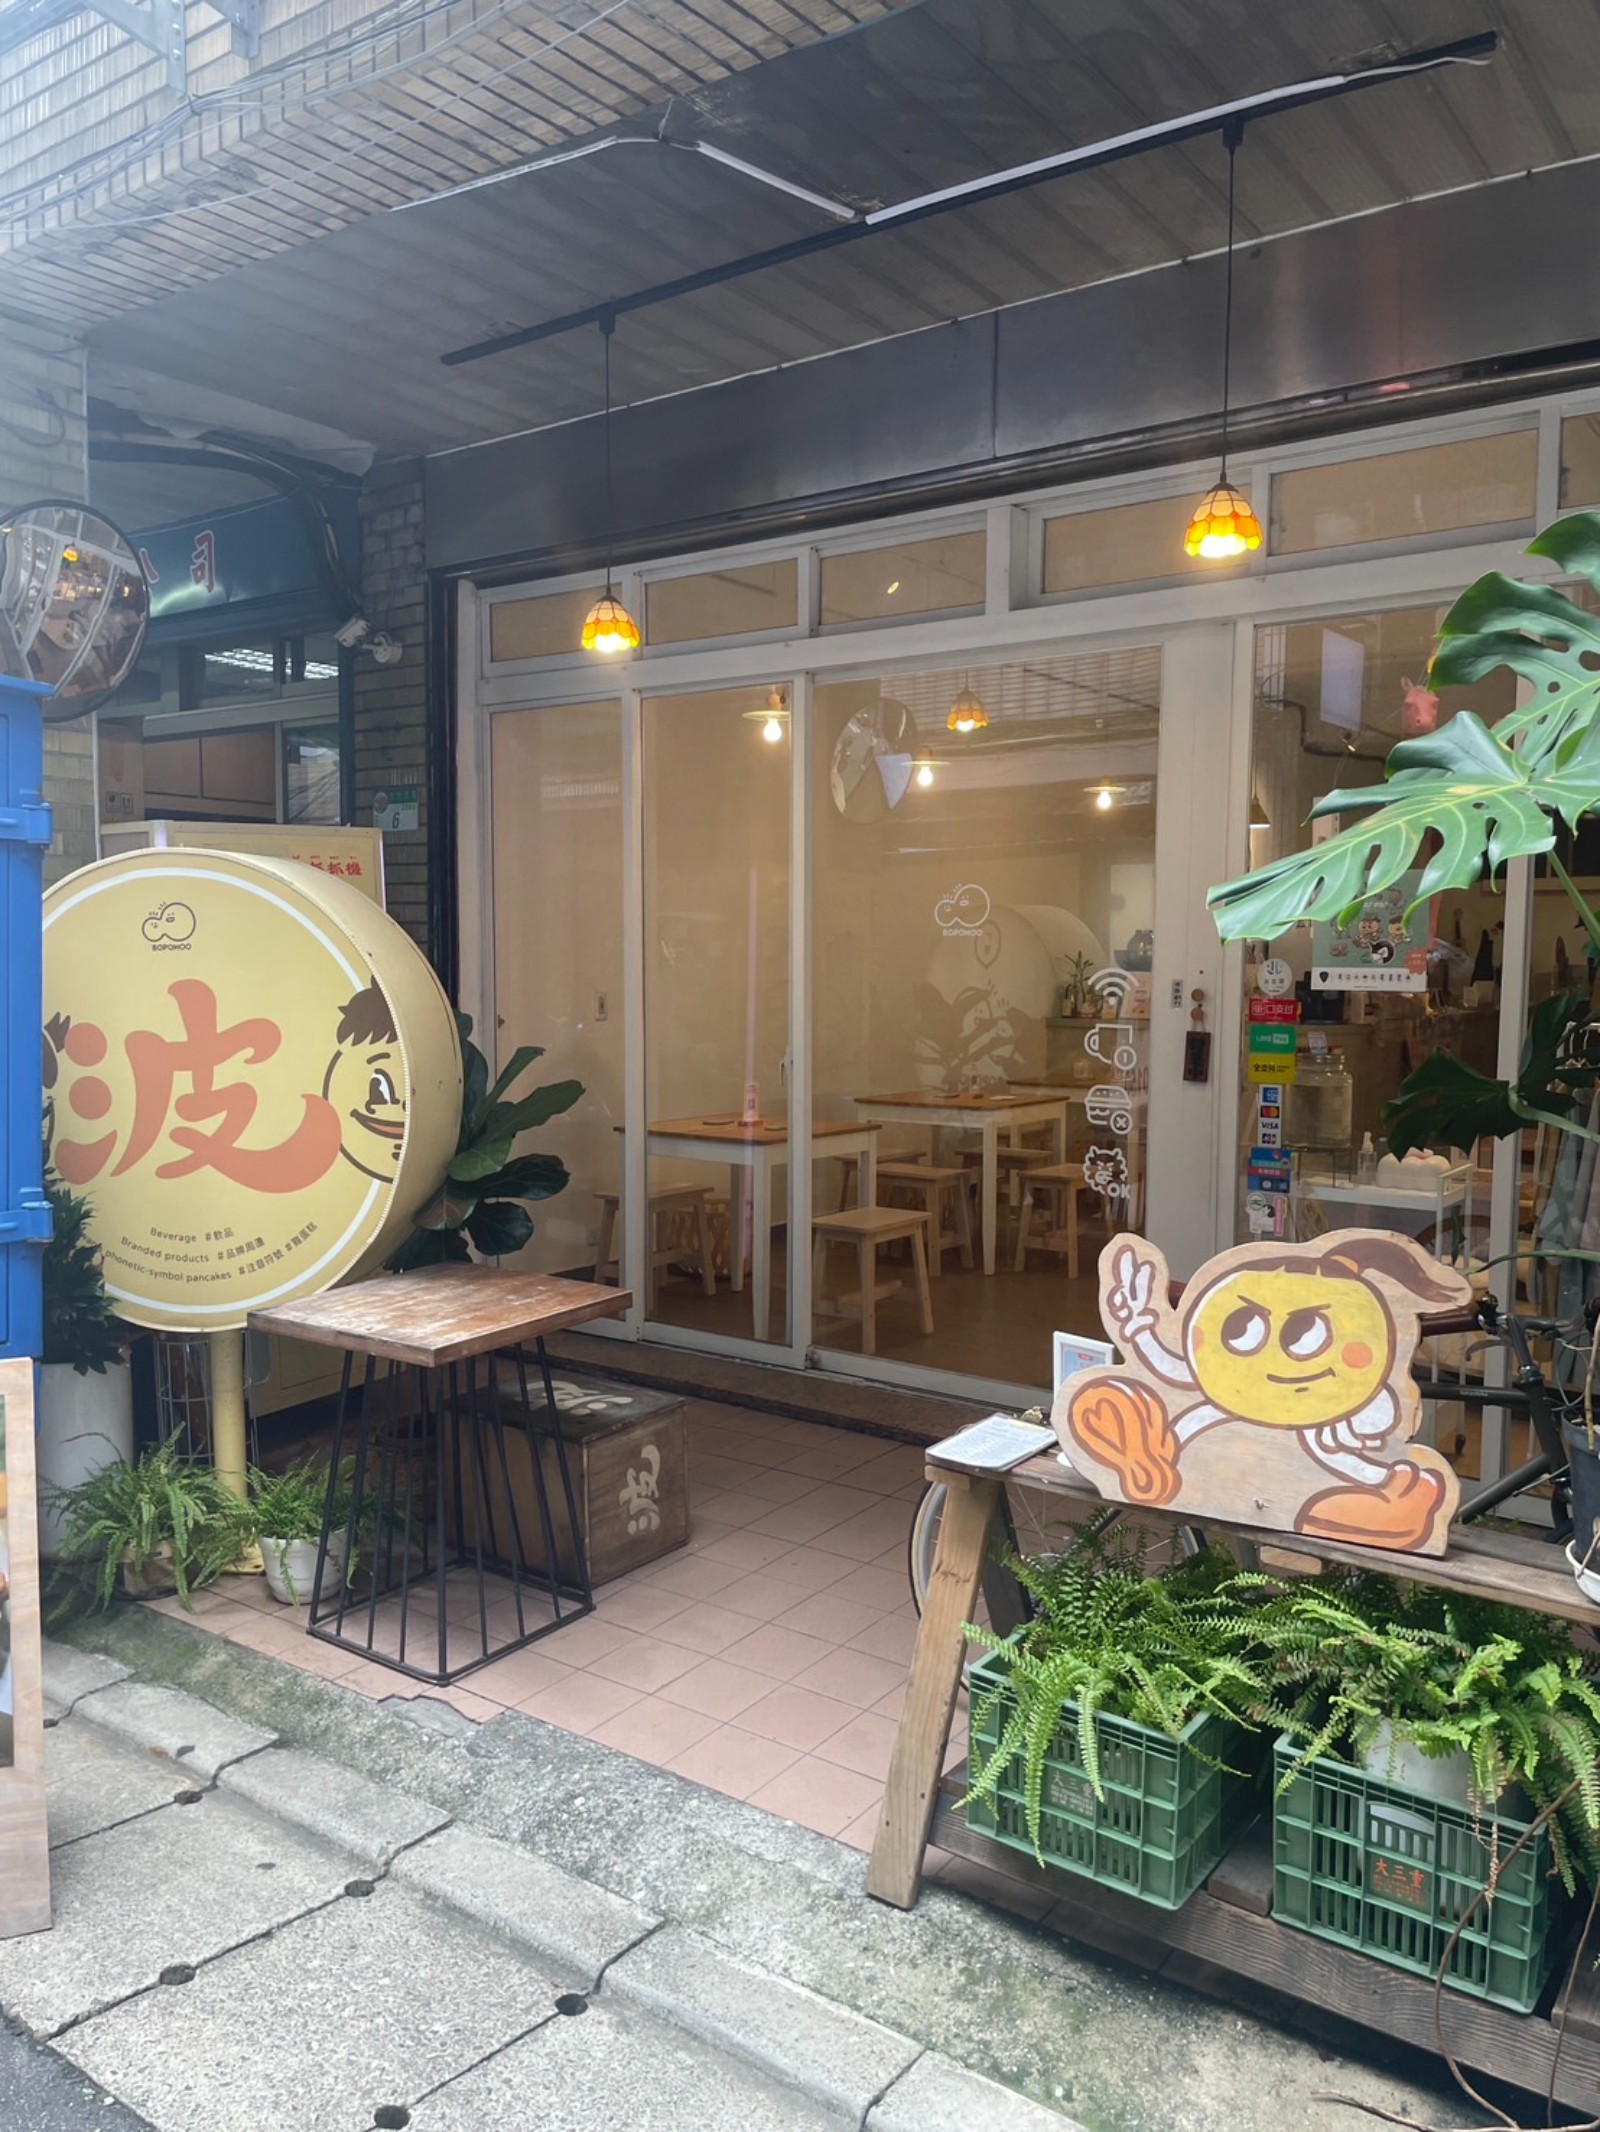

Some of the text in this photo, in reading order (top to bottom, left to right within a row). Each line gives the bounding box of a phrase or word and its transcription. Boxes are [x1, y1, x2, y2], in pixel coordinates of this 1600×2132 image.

[391, 811, 401, 829] 6
[54, 978, 342, 1194] 波
[1107, 1183, 1131, 1198] OK
[150, 1227, 197, 1243] Beverage
[120, 1236, 162, 1260] Branded
[164, 1251, 209, 1263] products
[186, 1271, 232, 1283] pancakes
[1375, 1857, 1425, 1892] 大三重
